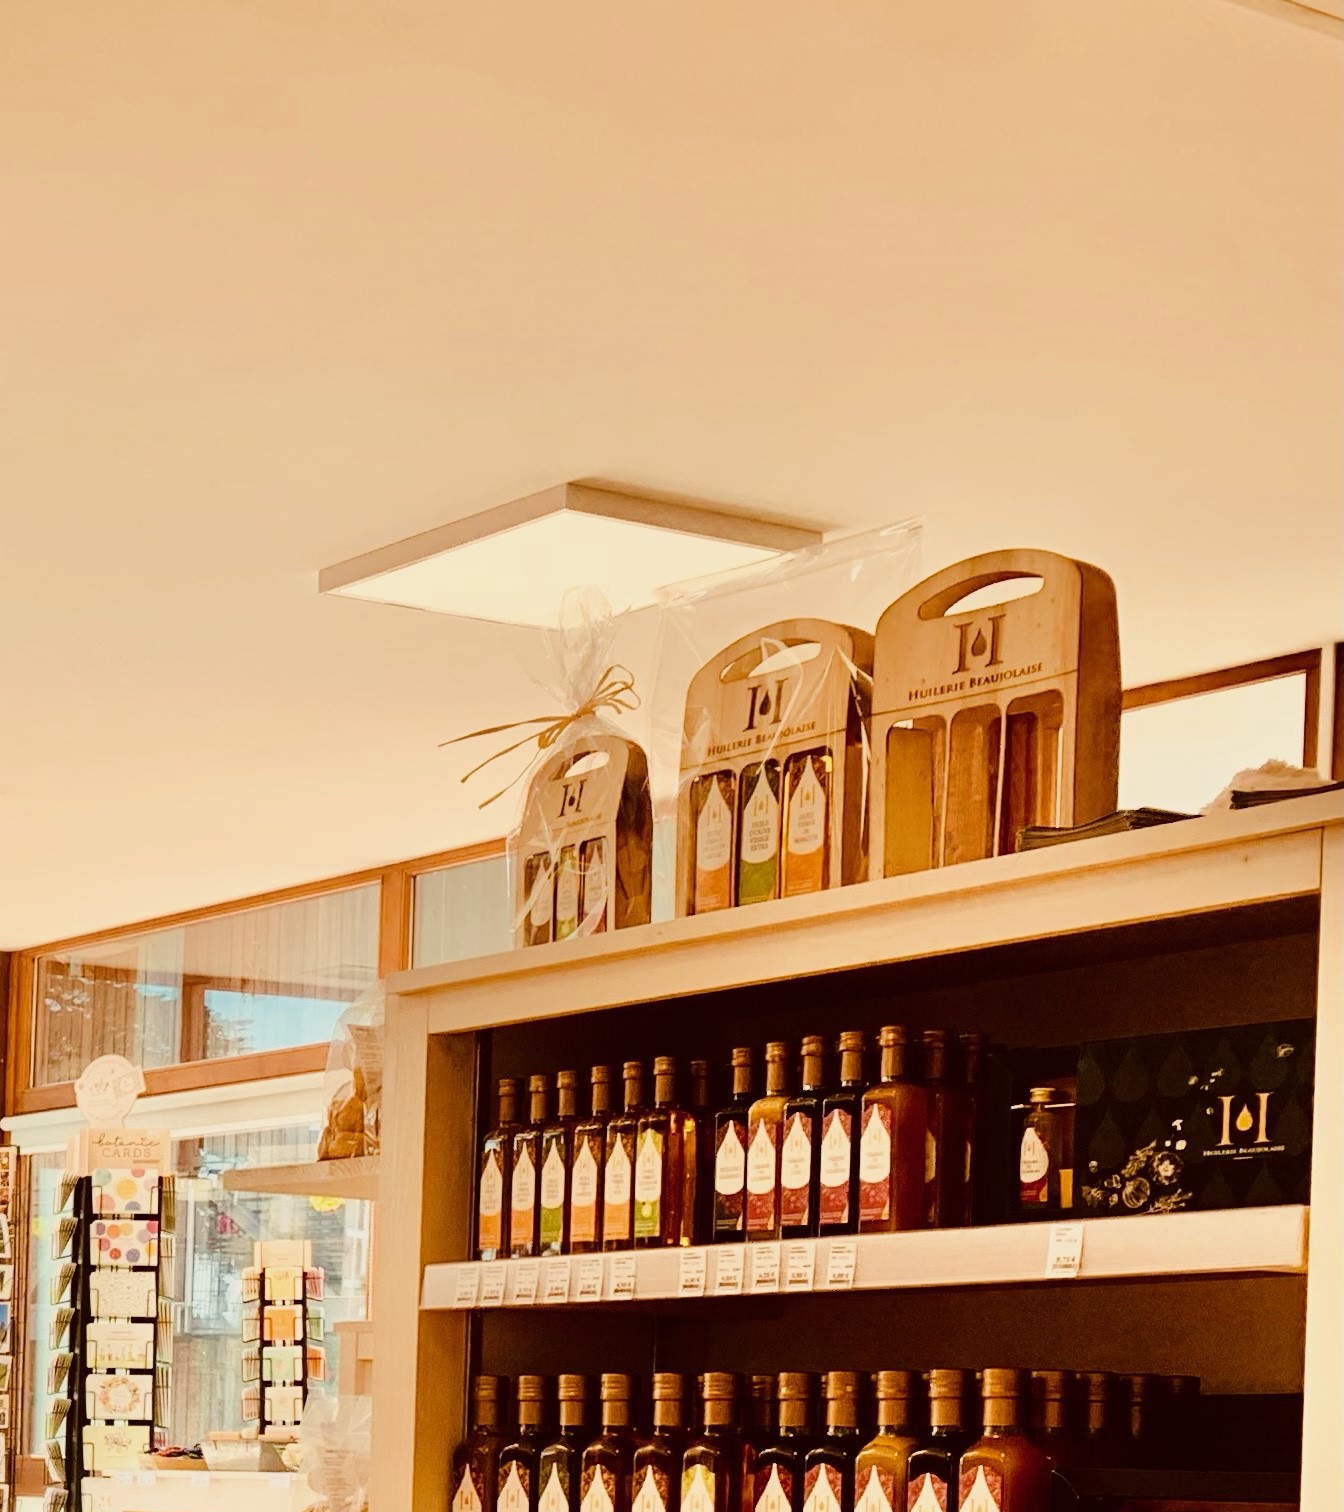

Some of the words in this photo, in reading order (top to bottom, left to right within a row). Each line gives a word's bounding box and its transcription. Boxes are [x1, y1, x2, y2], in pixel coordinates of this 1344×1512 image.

[908, 681, 965, 701] HUILERIE
[969, 662, 1043, 688] BEAUJOLAISE
[102, 1148, 152, 1158] CARDS
